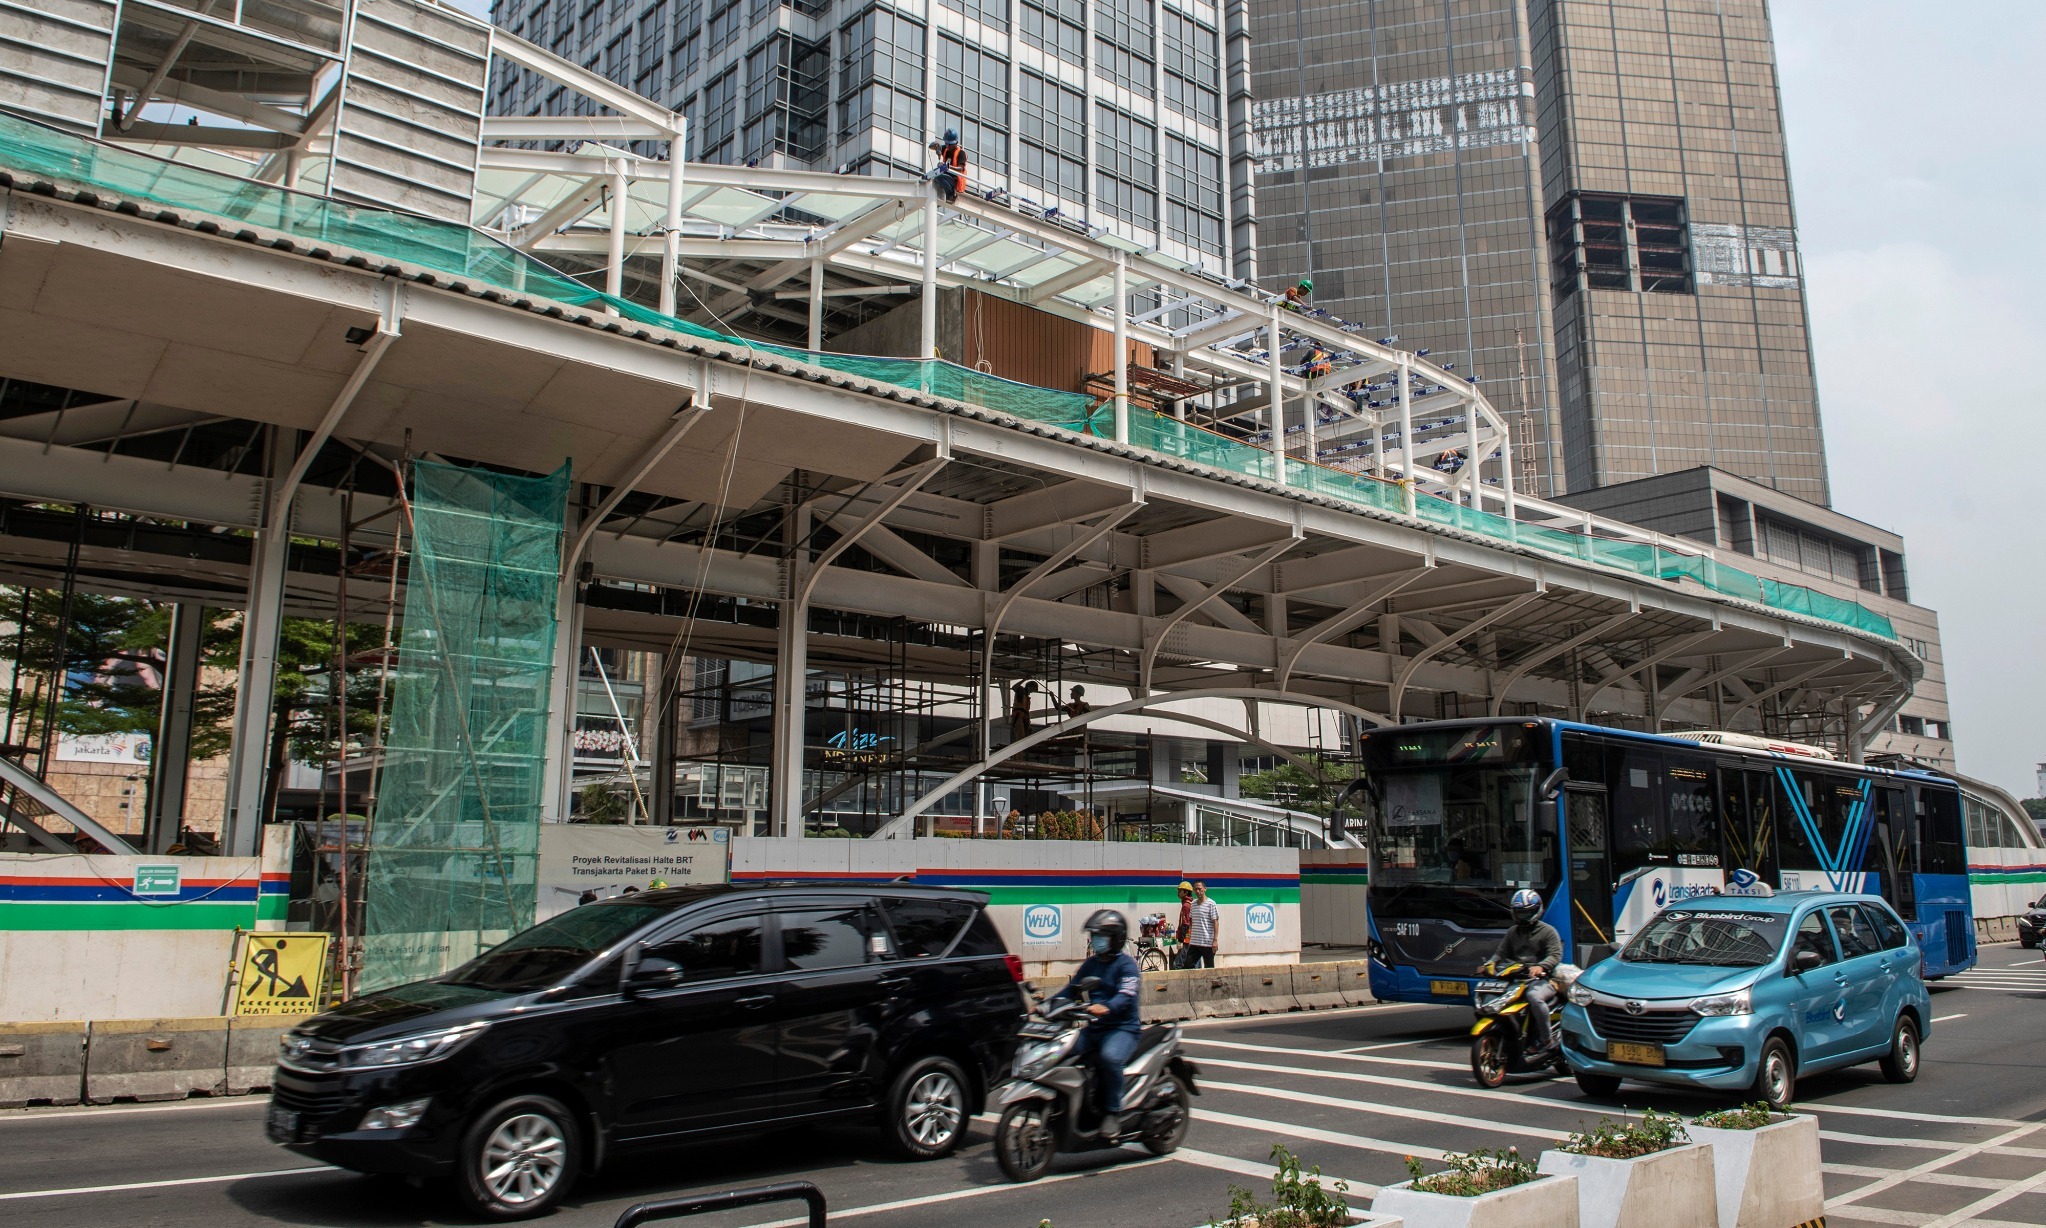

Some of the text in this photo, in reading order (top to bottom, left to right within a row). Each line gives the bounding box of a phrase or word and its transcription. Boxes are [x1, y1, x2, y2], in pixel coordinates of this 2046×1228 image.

[74, 744, 110, 756] jakarta
[572, 855, 693, 866] Proyek Revitalisasi Halte BRT
[572, 867, 623, 876] Transjakarta
[626, 867, 649, 875] Paket
[650, 867, 656, 875] B
[664, 867, 669, 875] 7
[671, 867, 691, 875] Halte
[1669, 883, 1715, 898] transjakarta
[1694, 912, 1775, 923] Bluebird Group
[1397, 922, 1420, 936] SAF 110
